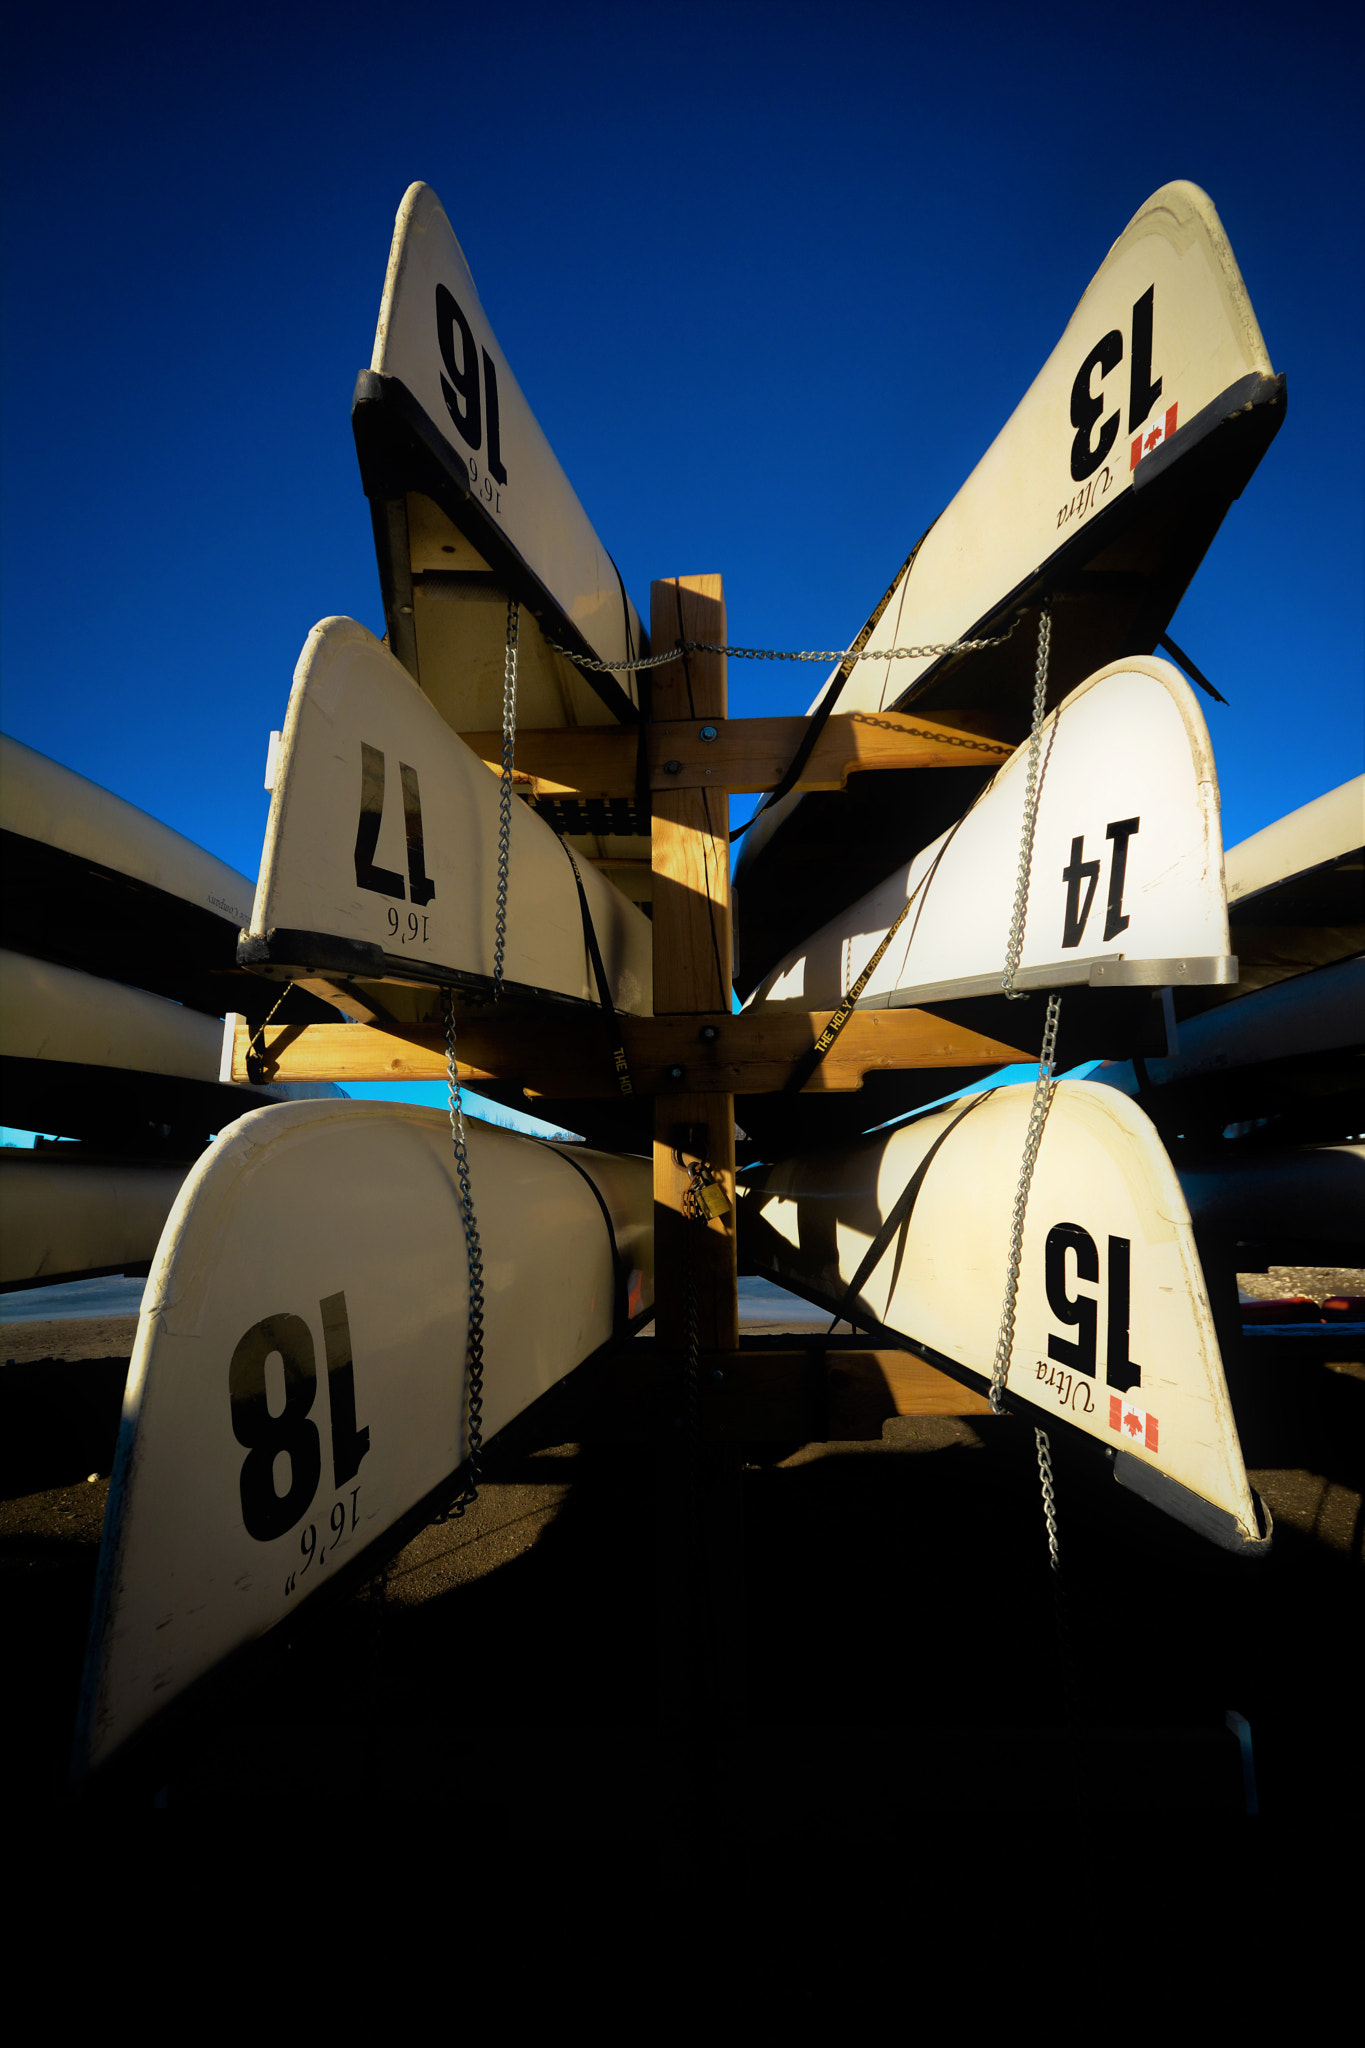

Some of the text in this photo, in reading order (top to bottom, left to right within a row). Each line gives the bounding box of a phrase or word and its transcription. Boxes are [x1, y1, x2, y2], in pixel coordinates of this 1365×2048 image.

[436, 283, 508, 486] 16
[1070, 282, 1163, 482] 13
[1056, 466, 1113, 530] Ultra
[840, 625, 873, 678] COMNY
[869, 589, 893, 624] CANOE
[354, 741, 436, 907] 17
[1061, 816, 1140, 948] 14
[813, 1029, 835, 1053] THE
[829, 999, 852, 1031] HOLY
[849, 974, 868, 1000] COW
[865, 939, 889, 975] CANOE
[612, 1046, 629, 1073] THE
[1045, 1222, 1141, 1393] 15
[229, 1290, 370, 1542] 18
[1036, 1361, 1095, 1413] Ultra
